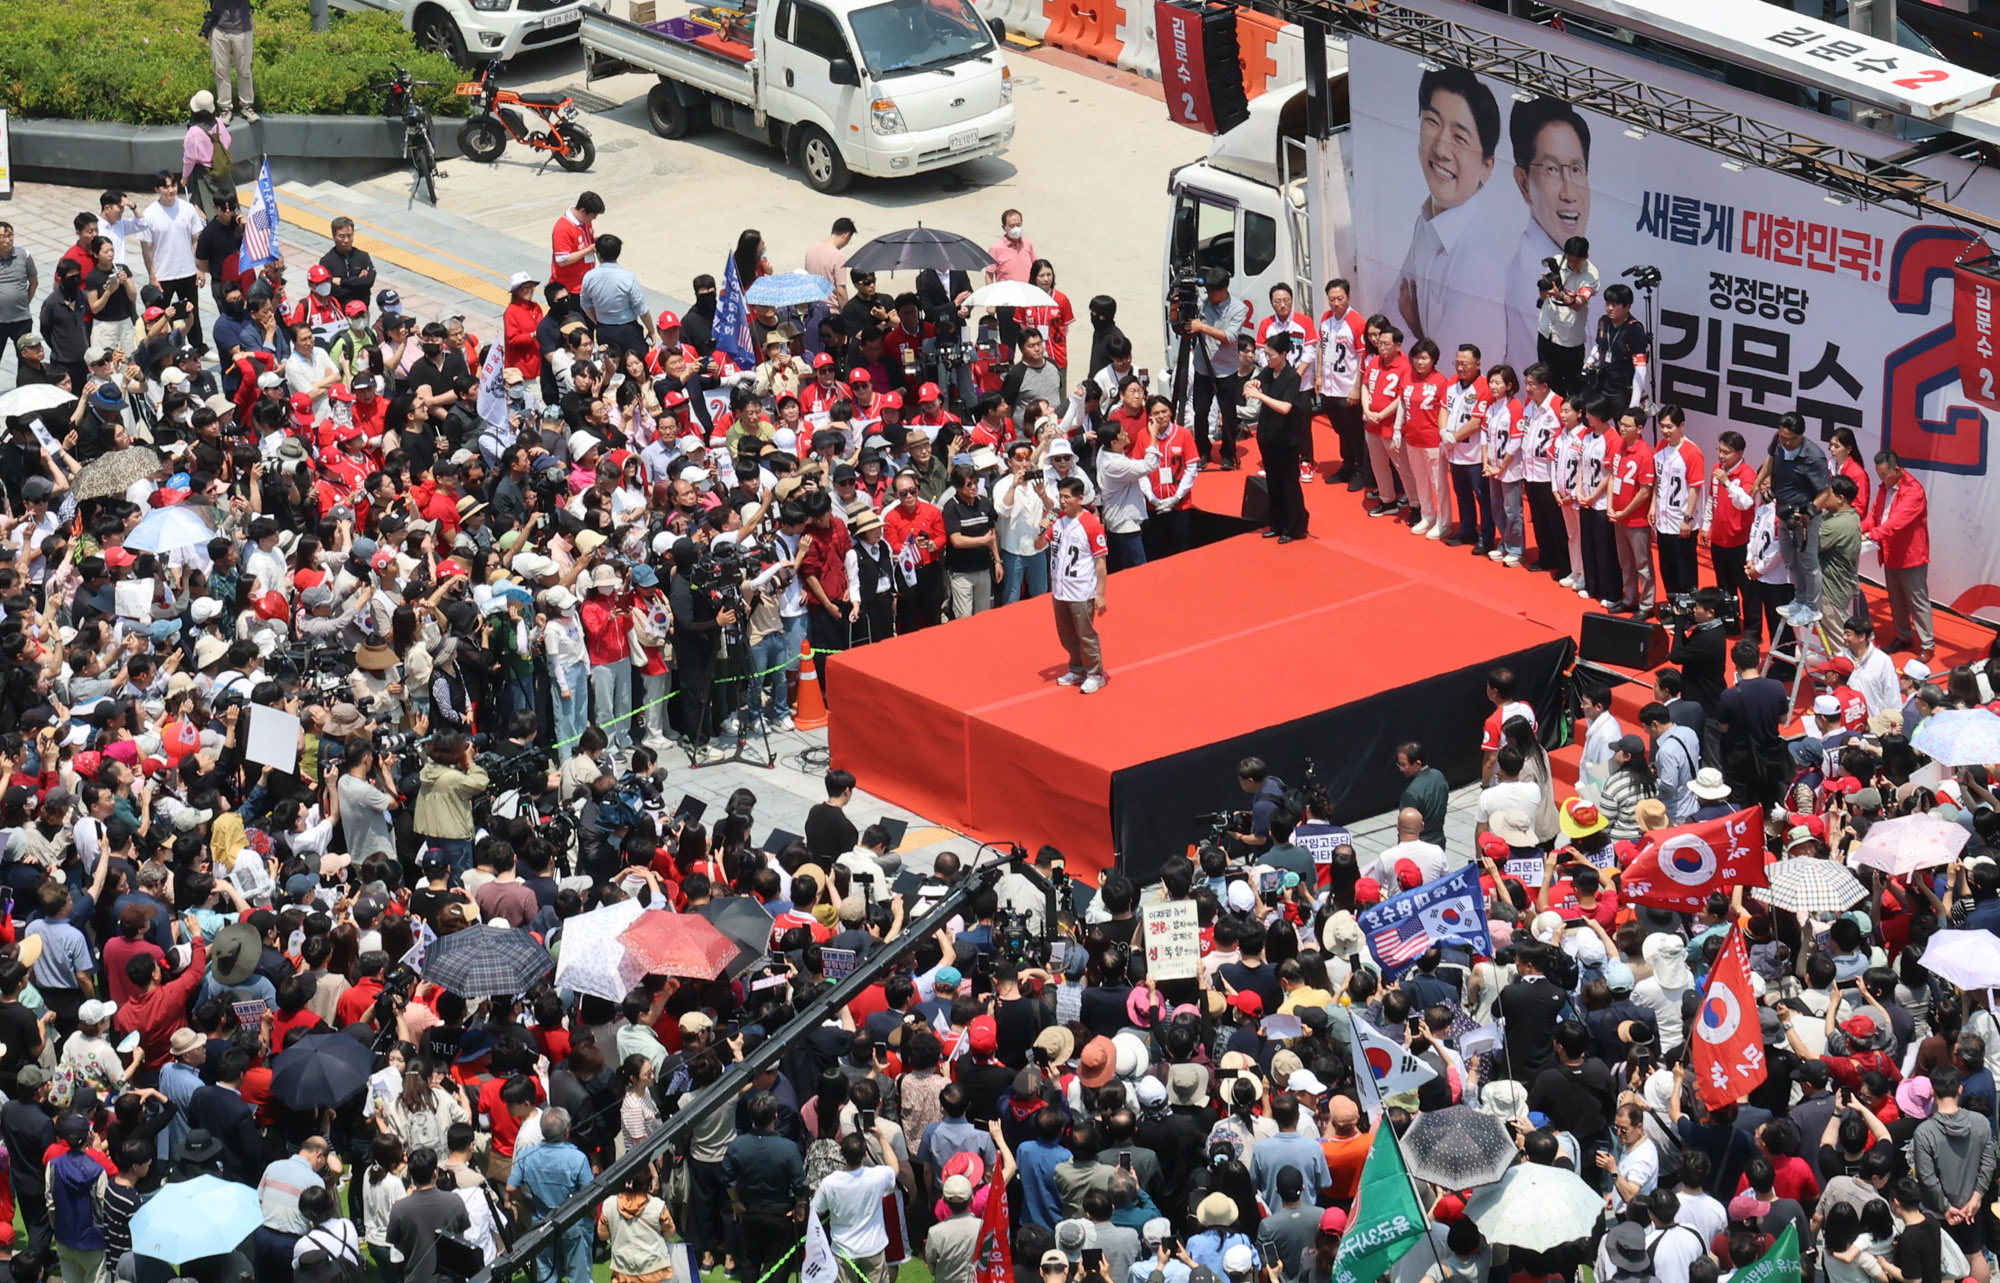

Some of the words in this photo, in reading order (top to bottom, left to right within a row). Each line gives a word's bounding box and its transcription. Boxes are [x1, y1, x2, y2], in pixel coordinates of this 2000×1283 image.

[1172, 16, 1192, 84] 김문수
[1182, 92, 1198, 121] 2
[1765, 26, 1899, 74] 김문수
[1891, 69, 1950, 90] 2
[1636, 190, 1735, 253] 새롭게
[1741, 209, 1885, 283] 대한민국!
[1709, 271, 1809, 325] 정정당당
[1976, 284, 1993, 359] 김문수
[1333, 343, 1347, 373] 2
[1881, 224, 1999, 476] 2
[1383, 373, 1399, 397] 2
[1659, 308, 1864, 443] 김문수
[1979, 368, 1996, 401] 2
[710, 398, 727, 426] 2
[1420, 390, 1437, 410] 2
[1497, 430, 1509, 460] 2
[1535, 428, 1550, 458] 2
[1566, 459, 1579, 490] 2
[1590, 458, 1601, 488] 2
[1623, 461, 1638, 486] 2
[1669, 476, 1682, 507] 2
[1759, 531, 1771, 560] 2
[1065, 545, 1080, 578] 2
